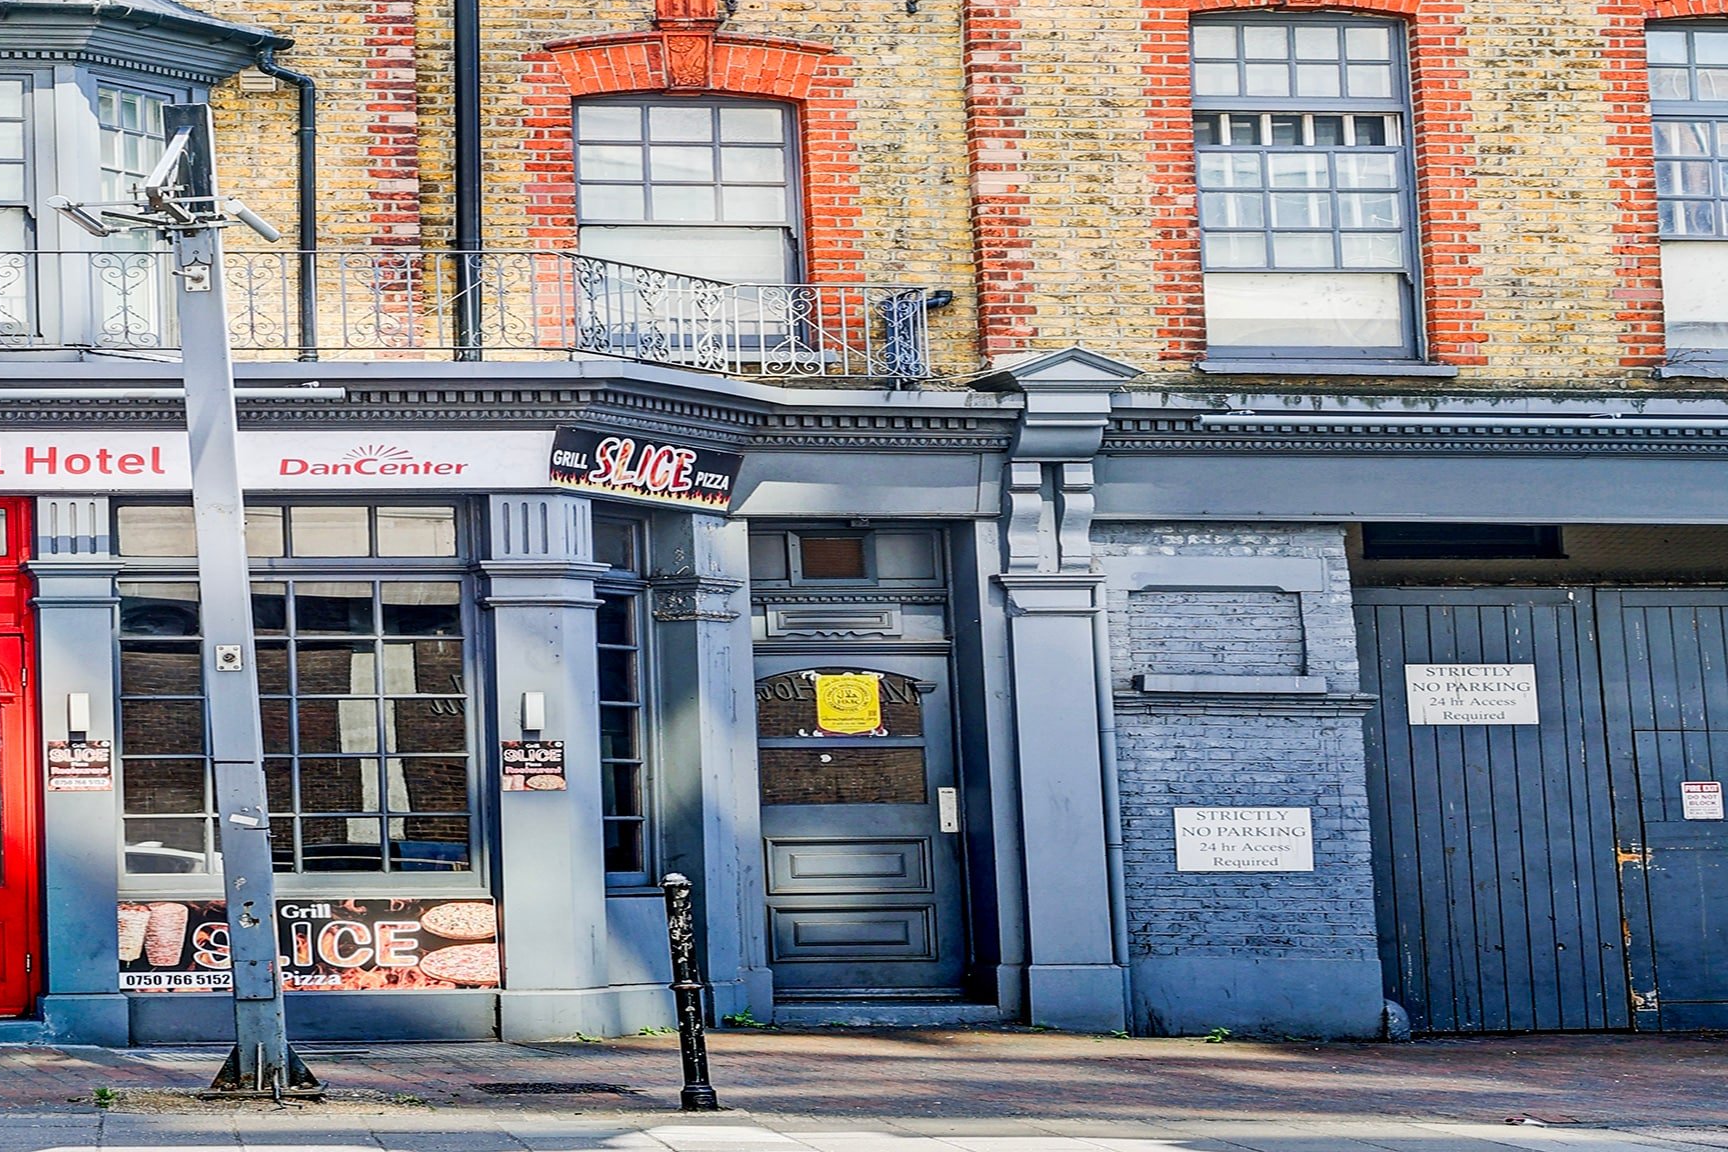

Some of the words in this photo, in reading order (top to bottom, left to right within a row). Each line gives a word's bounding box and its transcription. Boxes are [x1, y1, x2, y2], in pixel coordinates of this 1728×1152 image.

[24, 446, 166, 475] Hotel
[553, 450, 588, 469] GRILL
[589, 437, 697, 492] SLICE
[695, 471, 730, 490] PIZZA
[279, 458, 469, 476] DanCenter
[1425, 667, 1515, 677] STRICTLY
[1412, 682, 1440, 692] NO
[1446, 682, 1531, 692] PARKING
[1429, 697, 1446, 706] 24
[1450, 697, 1464, 706] hr
[1469, 697, 1517, 706] Access
[1443, 711, 1505, 722] Required
[49, 748, 110, 762] SLICE
[503, 748, 563, 762] SLICE
[1196, 811, 1289, 821] STRICTLY
[1182, 827, 1212, 837] NO
[1217, 827, 1306, 837] PARKING
[1199, 842, 1216, 852] 24
[1221, 842, 1236, 852] hr
[1241, 842, 1291, 852] Access
[1213, 856, 1279, 868] Required
[280, 903, 332, 919] Grill
[193, 921, 421, 969] SICE
[126, 974, 162, 986] 0750
[167, 974, 192, 986] 766
[196, 974, 230, 986] 5152
[280, 971, 342, 986] Pizza
